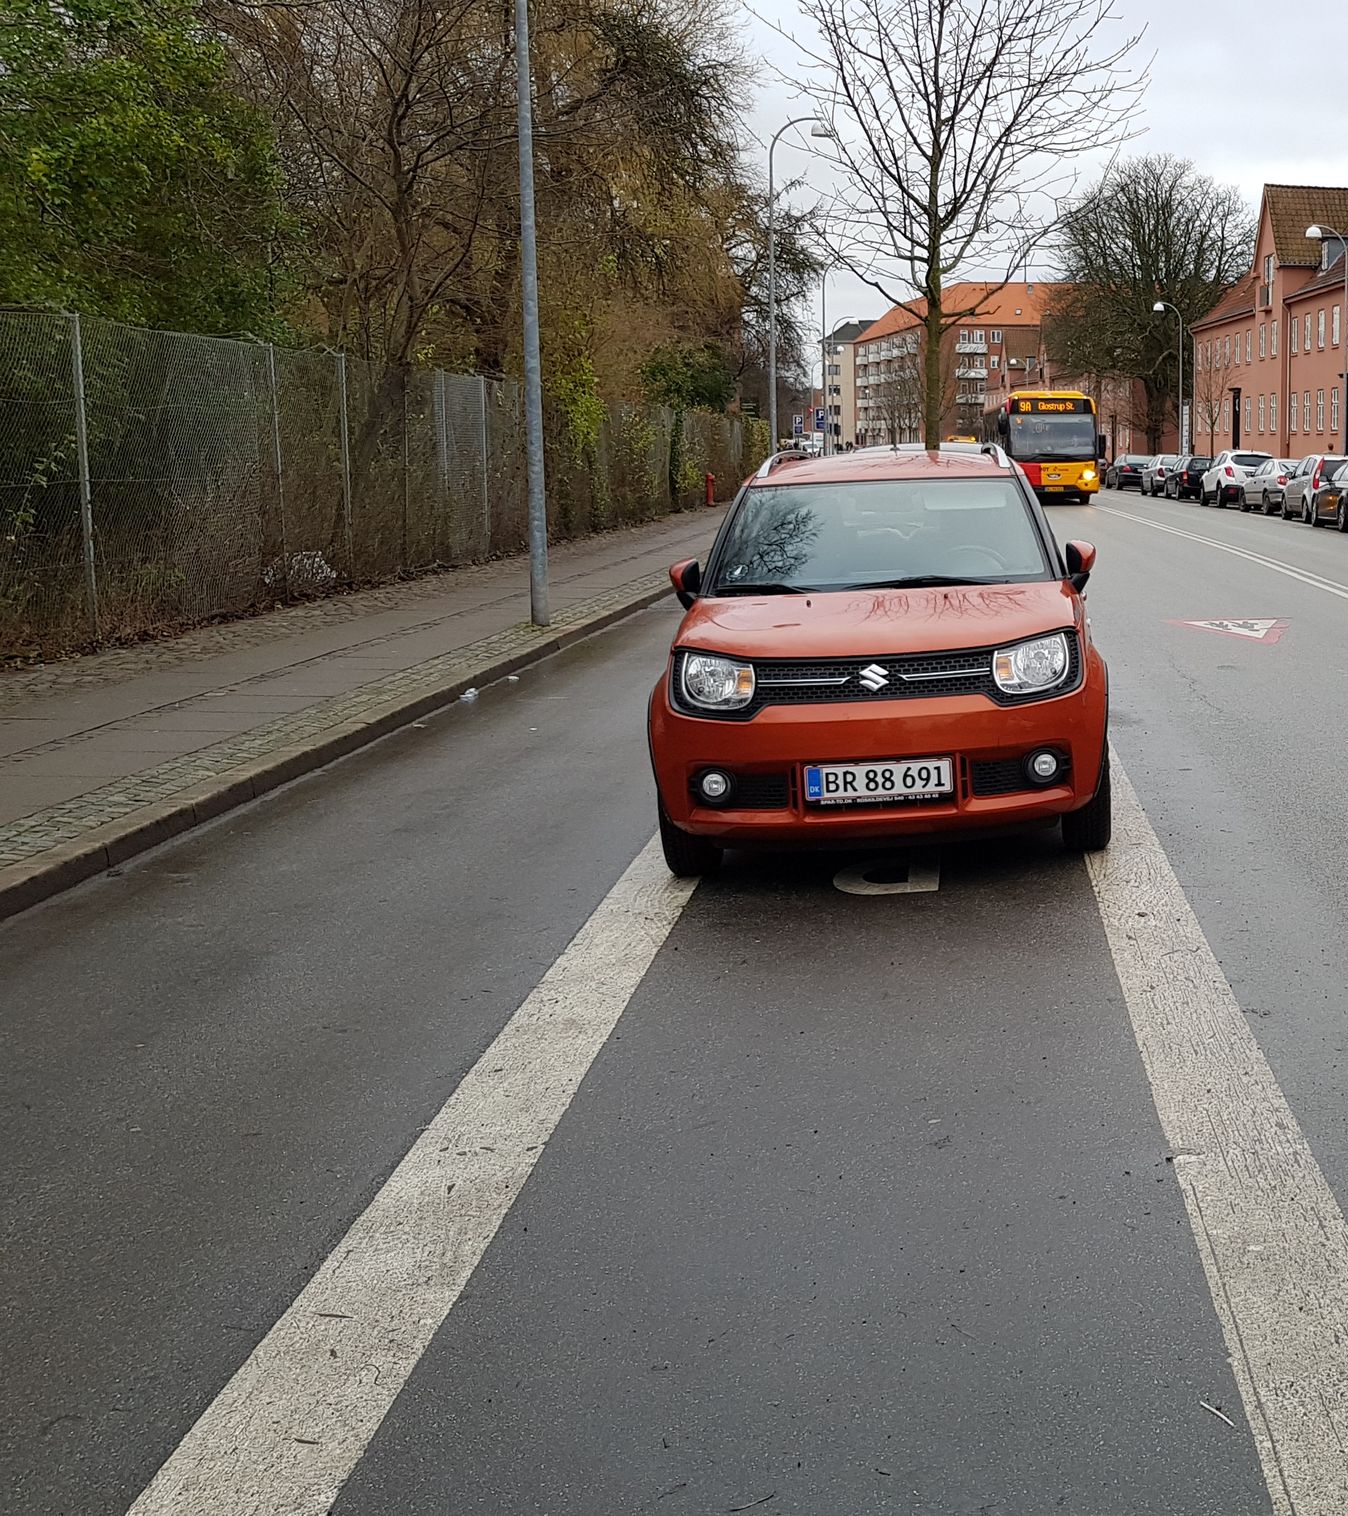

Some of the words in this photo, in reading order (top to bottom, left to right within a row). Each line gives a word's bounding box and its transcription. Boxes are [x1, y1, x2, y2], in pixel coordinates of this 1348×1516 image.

[1020, 402, 1031, 412] 9A
[1038, 402, 1065, 411] Glostrup
[1066, 402, 1075, 410] St.
[825, 770, 858, 793] BR
[865, 769, 896, 792] 88
[902, 766, 945, 789] 691
[809, 785, 820, 793] DK
